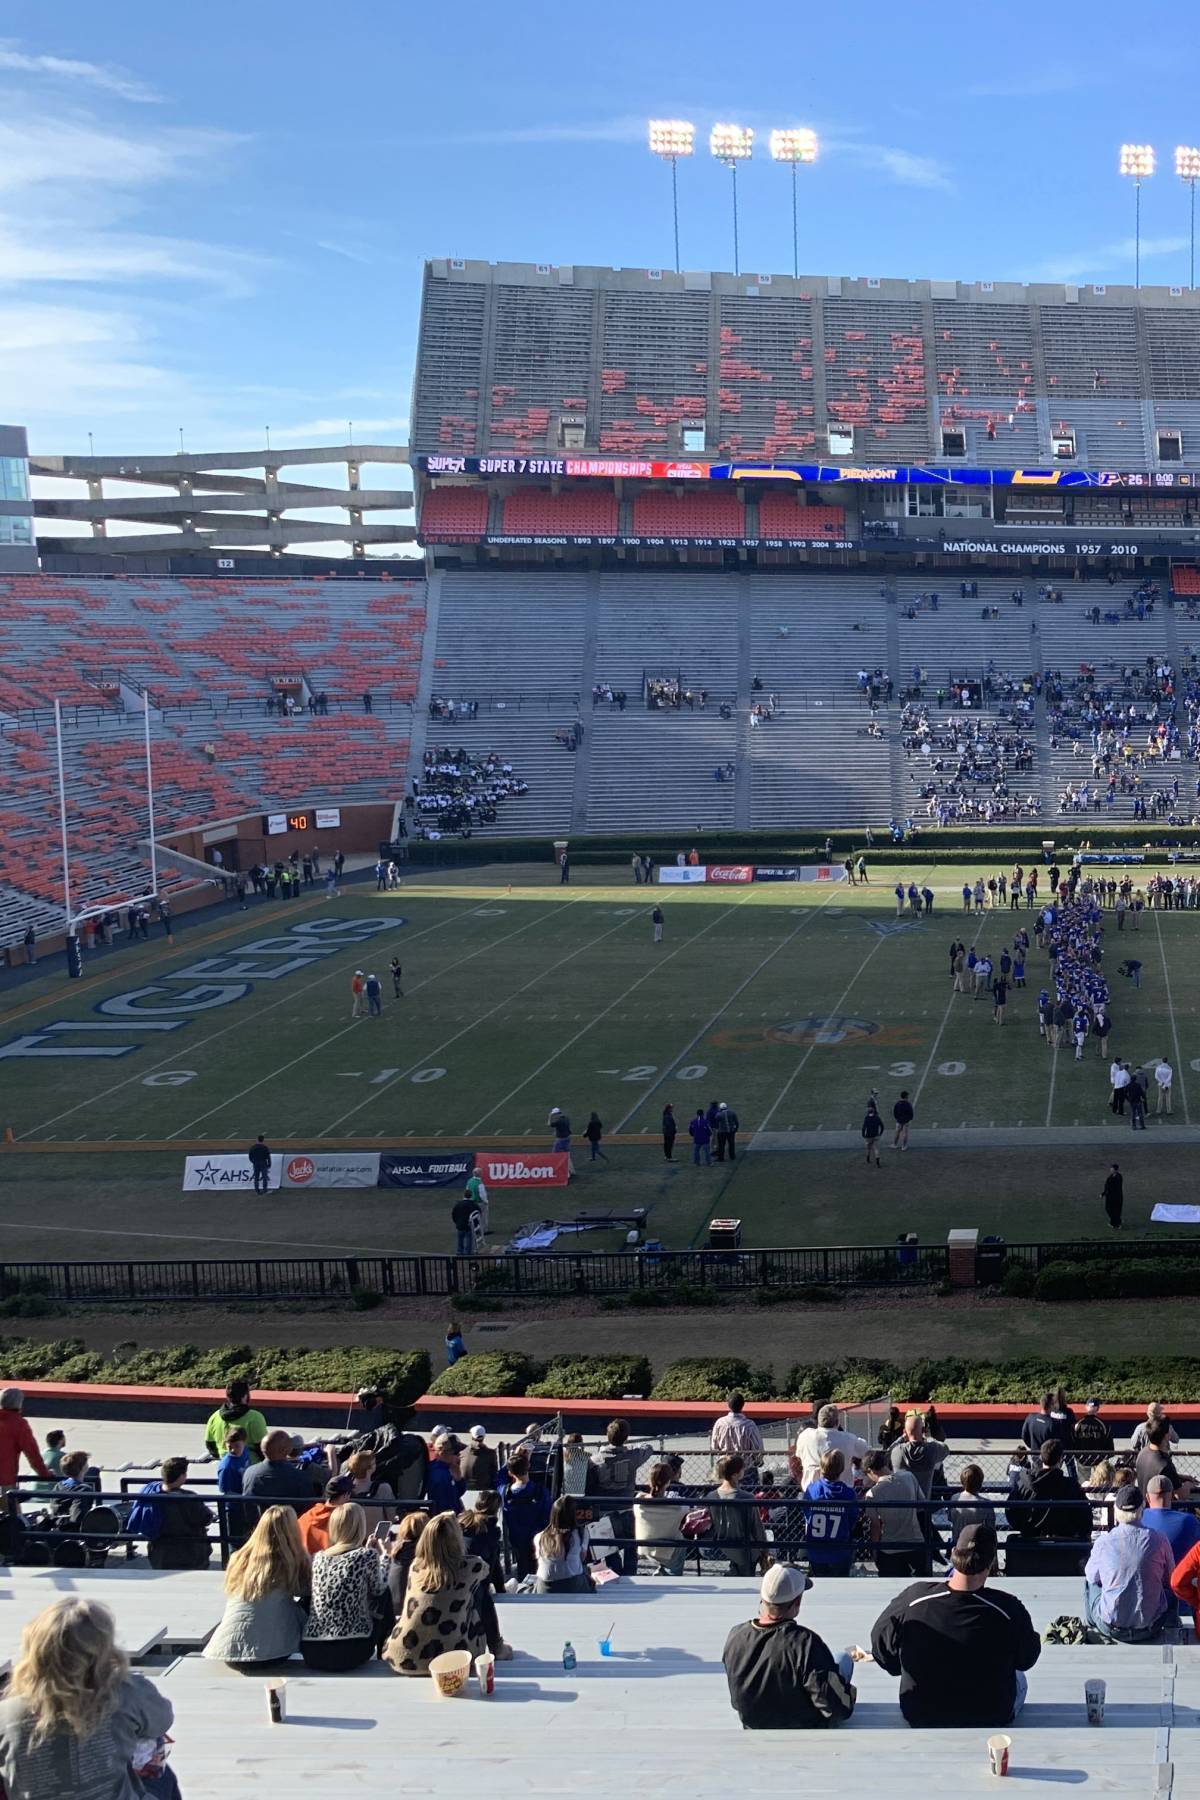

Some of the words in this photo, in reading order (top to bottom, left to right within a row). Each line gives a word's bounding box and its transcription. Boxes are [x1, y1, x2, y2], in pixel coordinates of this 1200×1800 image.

[480, 460, 515, 472] SUPER
[519, 460, 527, 473] 7
[529, 460, 563, 474] STATE
[567, 460, 652, 476] CHAMPIONSHIPS
[840, 468, 897, 480] PIEDMONT
[1128, 474, 1143, 485] 26
[1156, 473, 1174, 482] 0:00
[943, 542, 998, 552] NATIONAL
[1001, 544, 1065, 554] CHAMPIONS
[1075, 544, 1101, 554] 1957
[1111, 545, 1138, 554] 2010
[290, 816, 307, 829] 40
[711, 867, 747, 880] Coca-Cola
[0, 916, 408, 1061] TIGERS
[369, 1067, 447, 1083] 10
[621, 1064, 708, 1081] 20
[887, 1061, 967, 1077] 30
[142, 1070, 198, 1087] G
[392, 1166, 423, 1175] AHSAA
[428, 1163, 467, 1173] FOOTBALL
[488, 1161, 554, 1180] Wilson
[576, 1508, 594, 1520] 28
[811, 1513, 841, 1538] 97
